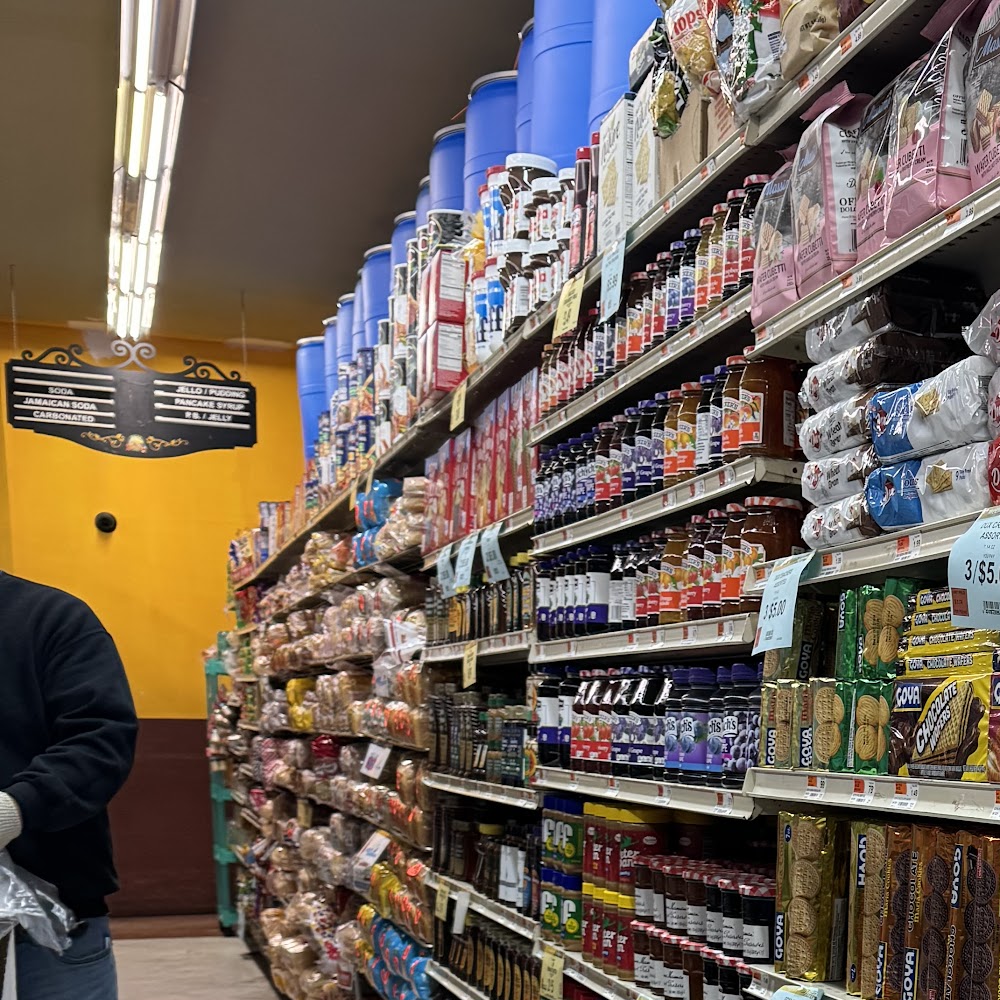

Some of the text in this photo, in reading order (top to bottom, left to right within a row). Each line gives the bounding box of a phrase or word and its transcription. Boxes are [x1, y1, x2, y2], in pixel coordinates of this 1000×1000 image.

[48, 387, 74, 396] SODA
[23, 398, 97, 411] JAMAICAN SODA
[174, 398, 245, 411] PANCAKE SYRUP
[33, 411, 95, 422] CARBONATED
[207, 413, 232, 422] JELLY
[896, 685, 920, 706] GOYA
[916, 680, 958, 755] CHOCOLATE
[930, 703, 951, 751] WAFERS
[801, 728, 813, 766] GOYA
[774, 914, 784, 959] GOYA
